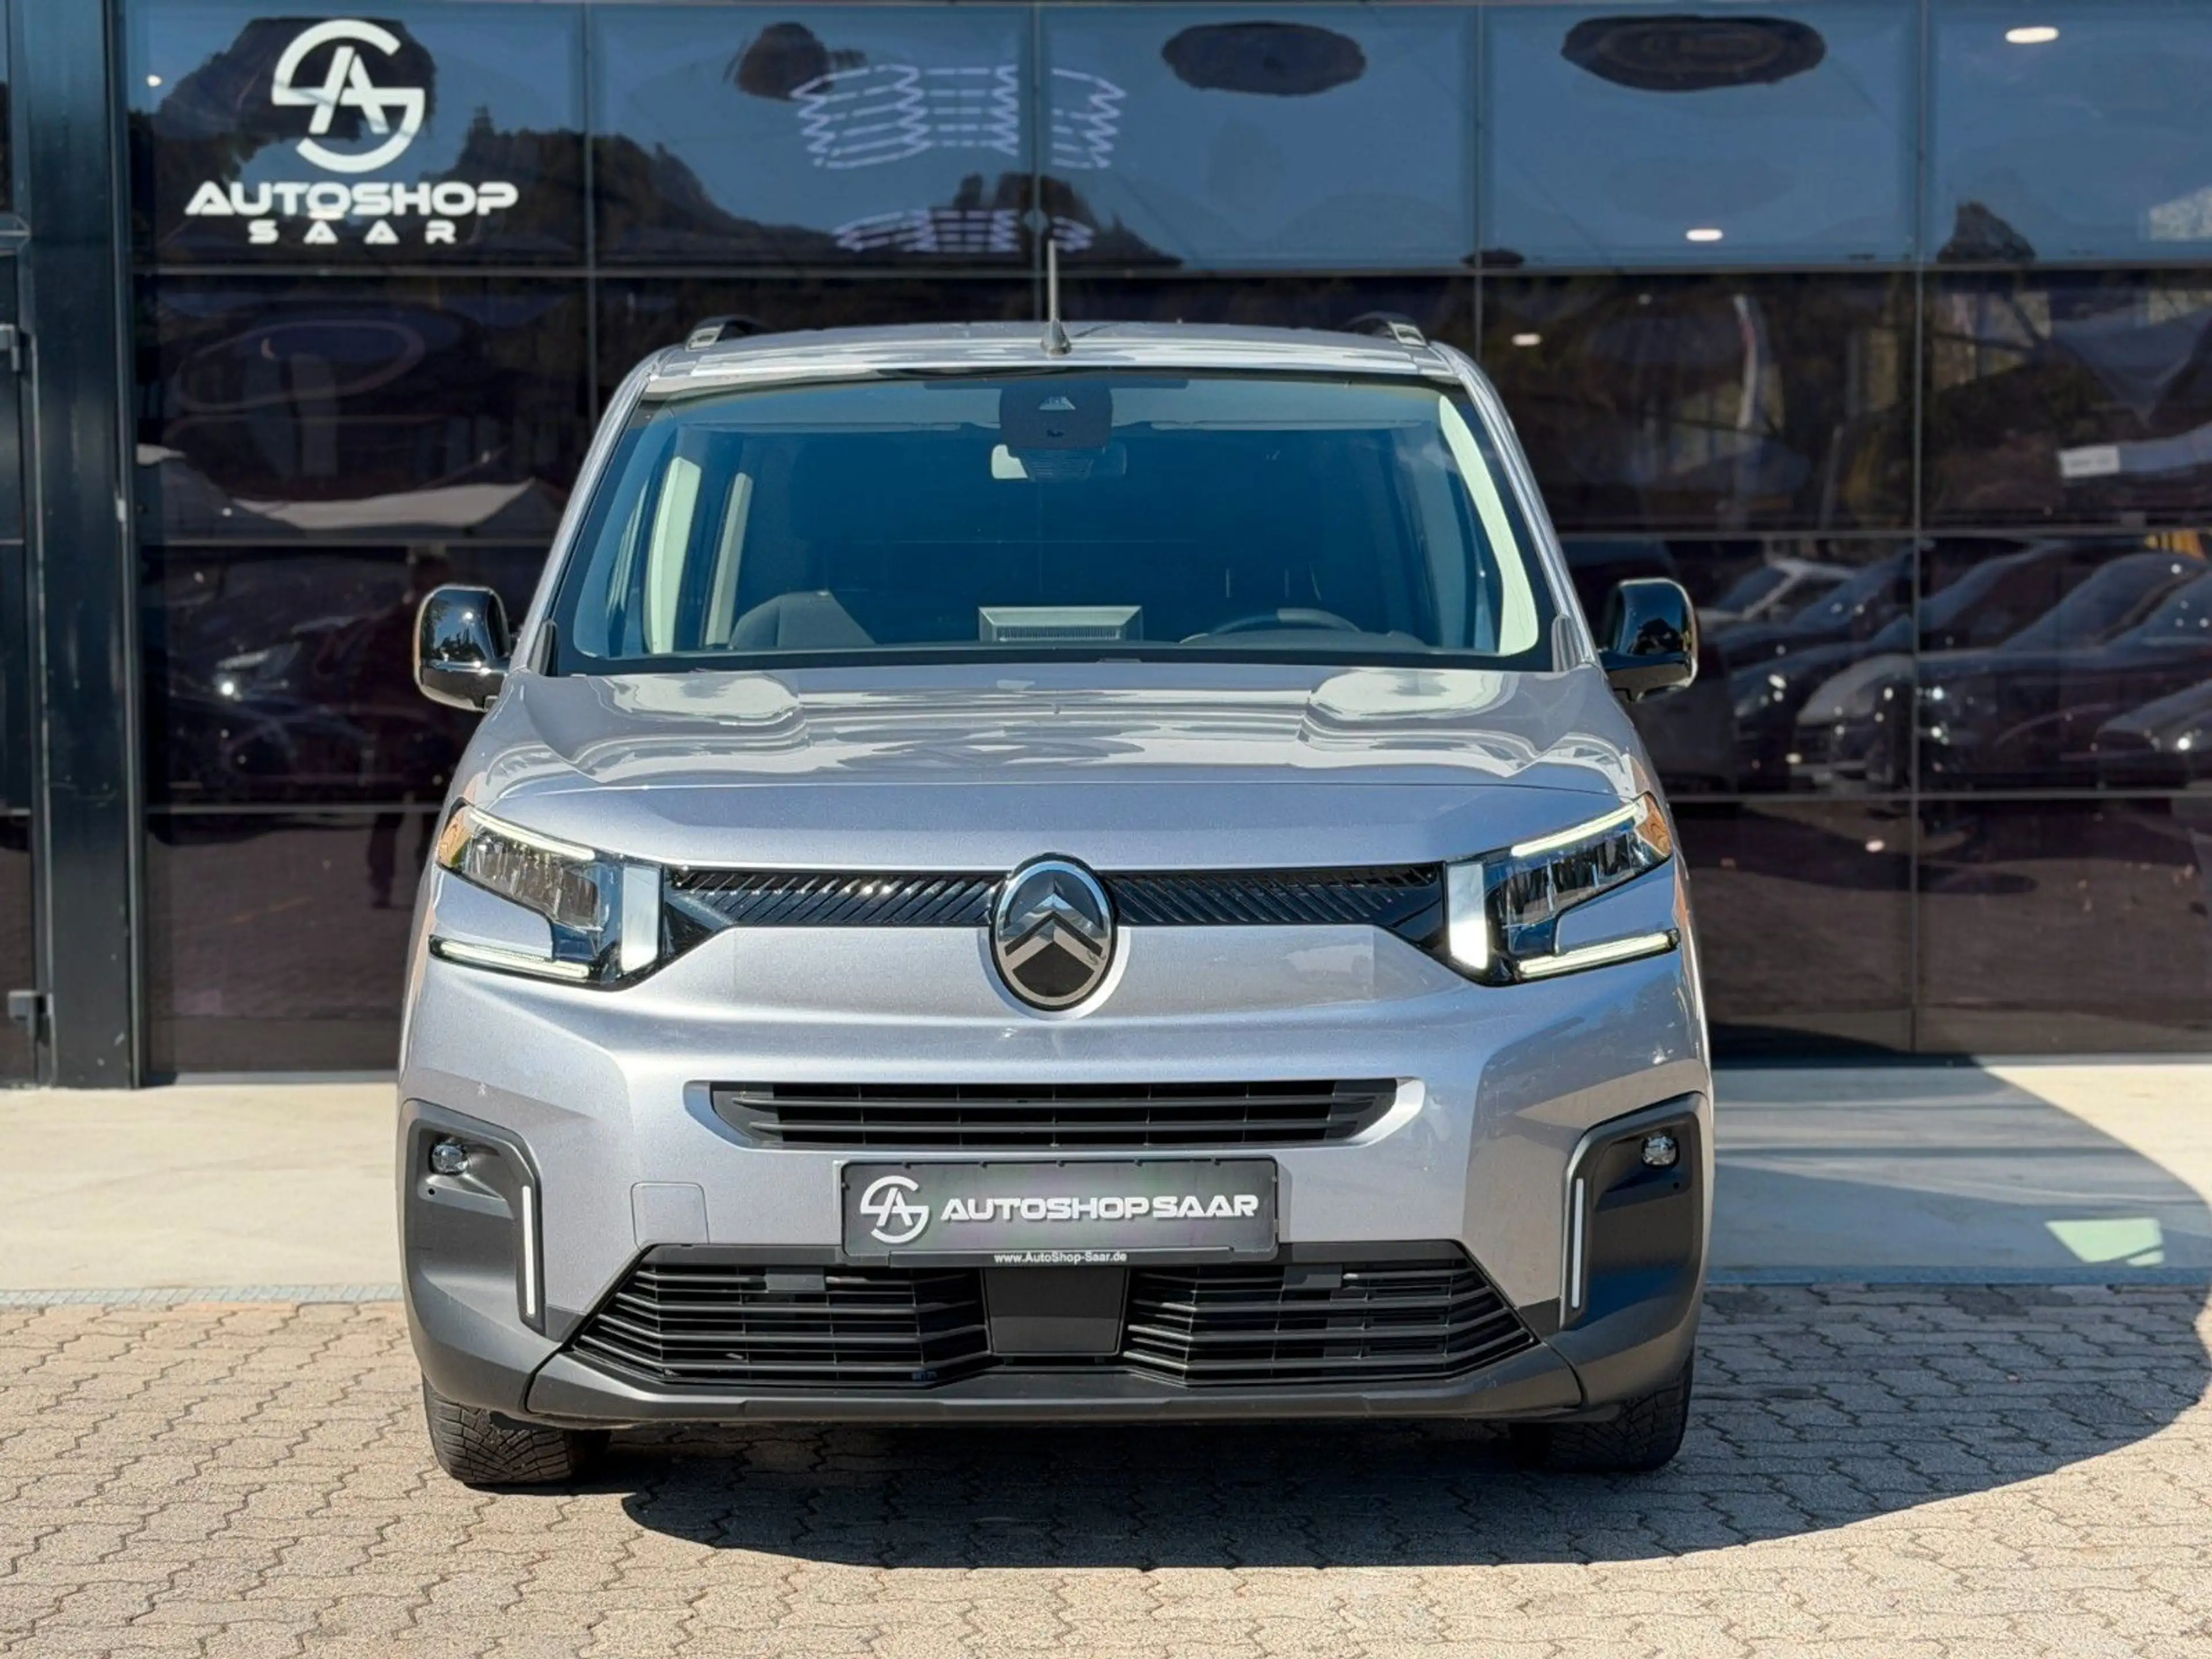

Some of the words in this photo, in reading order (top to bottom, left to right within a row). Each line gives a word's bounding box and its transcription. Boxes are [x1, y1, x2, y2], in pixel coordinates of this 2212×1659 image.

[185, 182, 517, 218] AUTOSHOP
[248, 220, 456, 244] SAAR
[994, 1252, 1127, 1264] www.AutoShop-Saar.de
